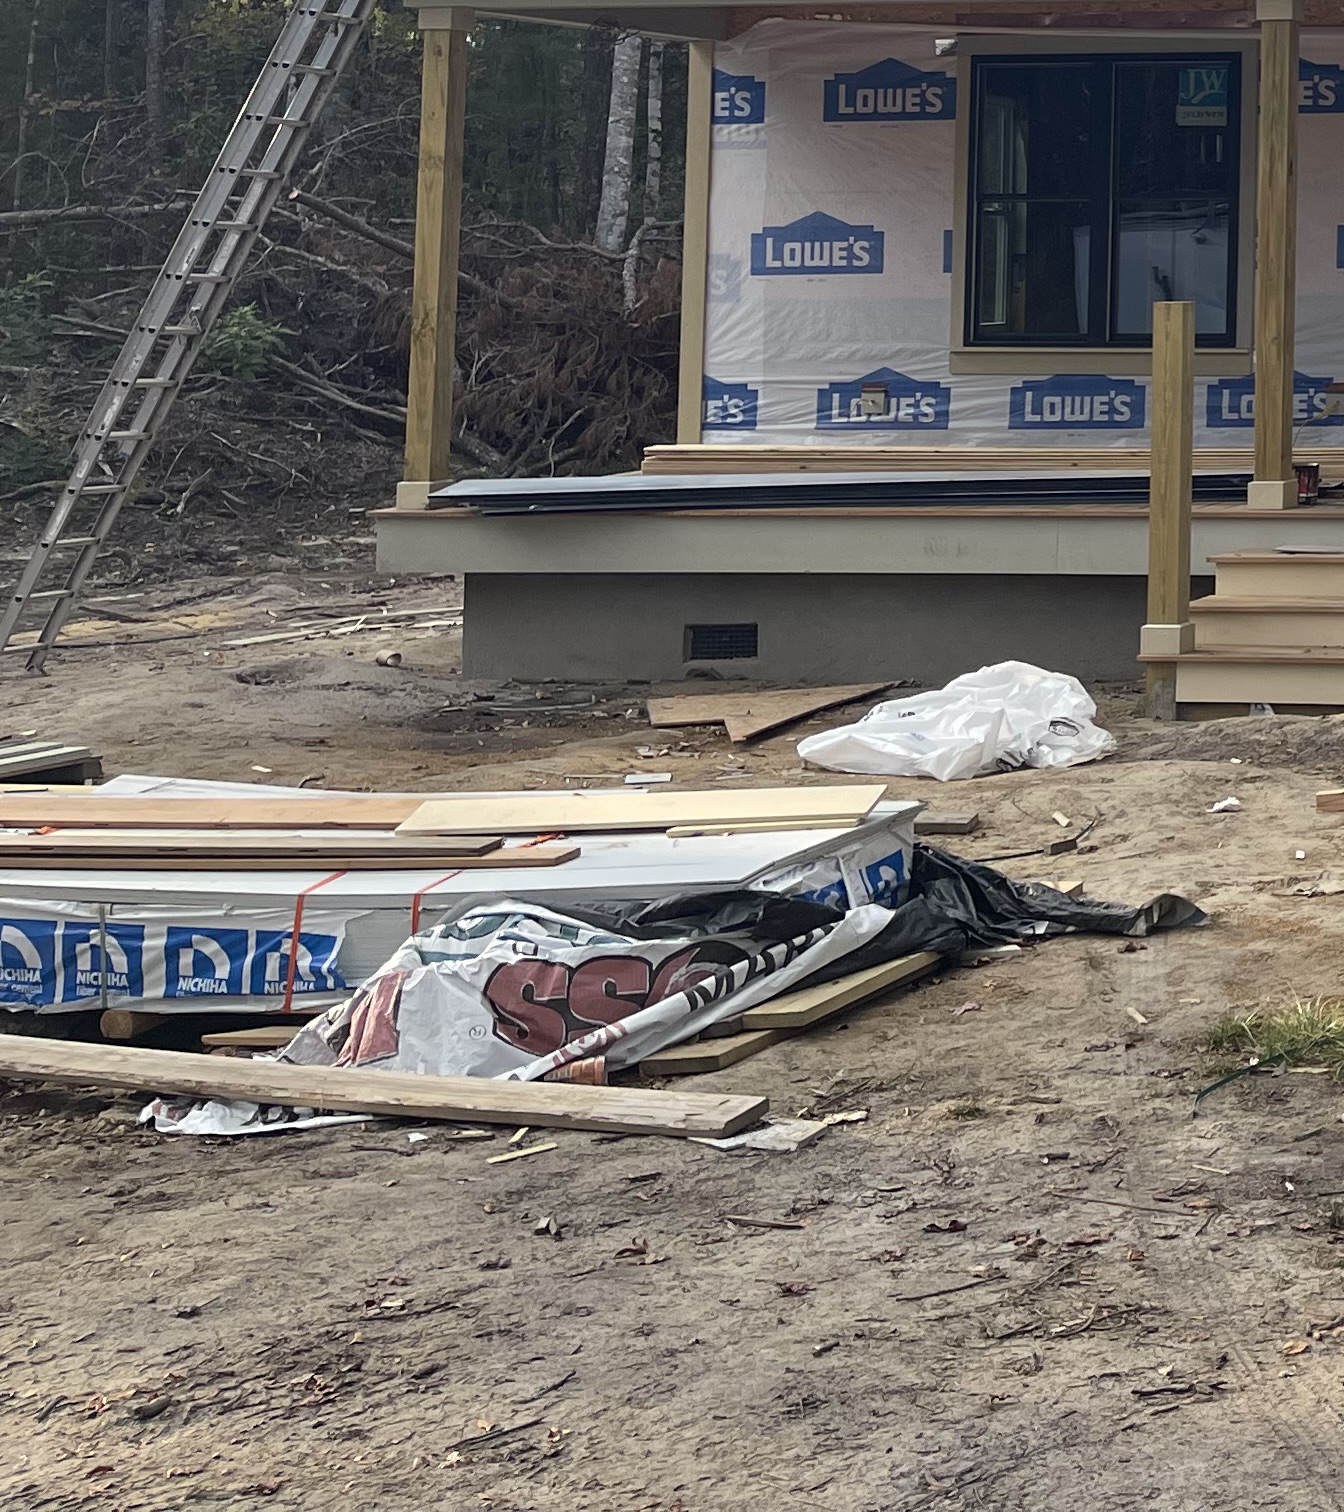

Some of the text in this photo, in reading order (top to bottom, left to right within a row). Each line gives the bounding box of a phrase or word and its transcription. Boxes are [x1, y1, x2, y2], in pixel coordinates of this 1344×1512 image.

[838, 82, 942, 114] LOWE'S
[1180, 69, 1228, 99] JW
[1298, 75, 1336, 106] E'S
[714, 87, 752, 117] E'S
[765, 237, 870, 268] LOWE'S
[707, 395, 744, 424] E'S
[1024, 391, 1131, 422] LOWE'S
[1222, 389, 1327, 419] LOE'S
[0, 968, 42, 983] ICHIHA
[177, 977, 228, 994] NICHIHA
